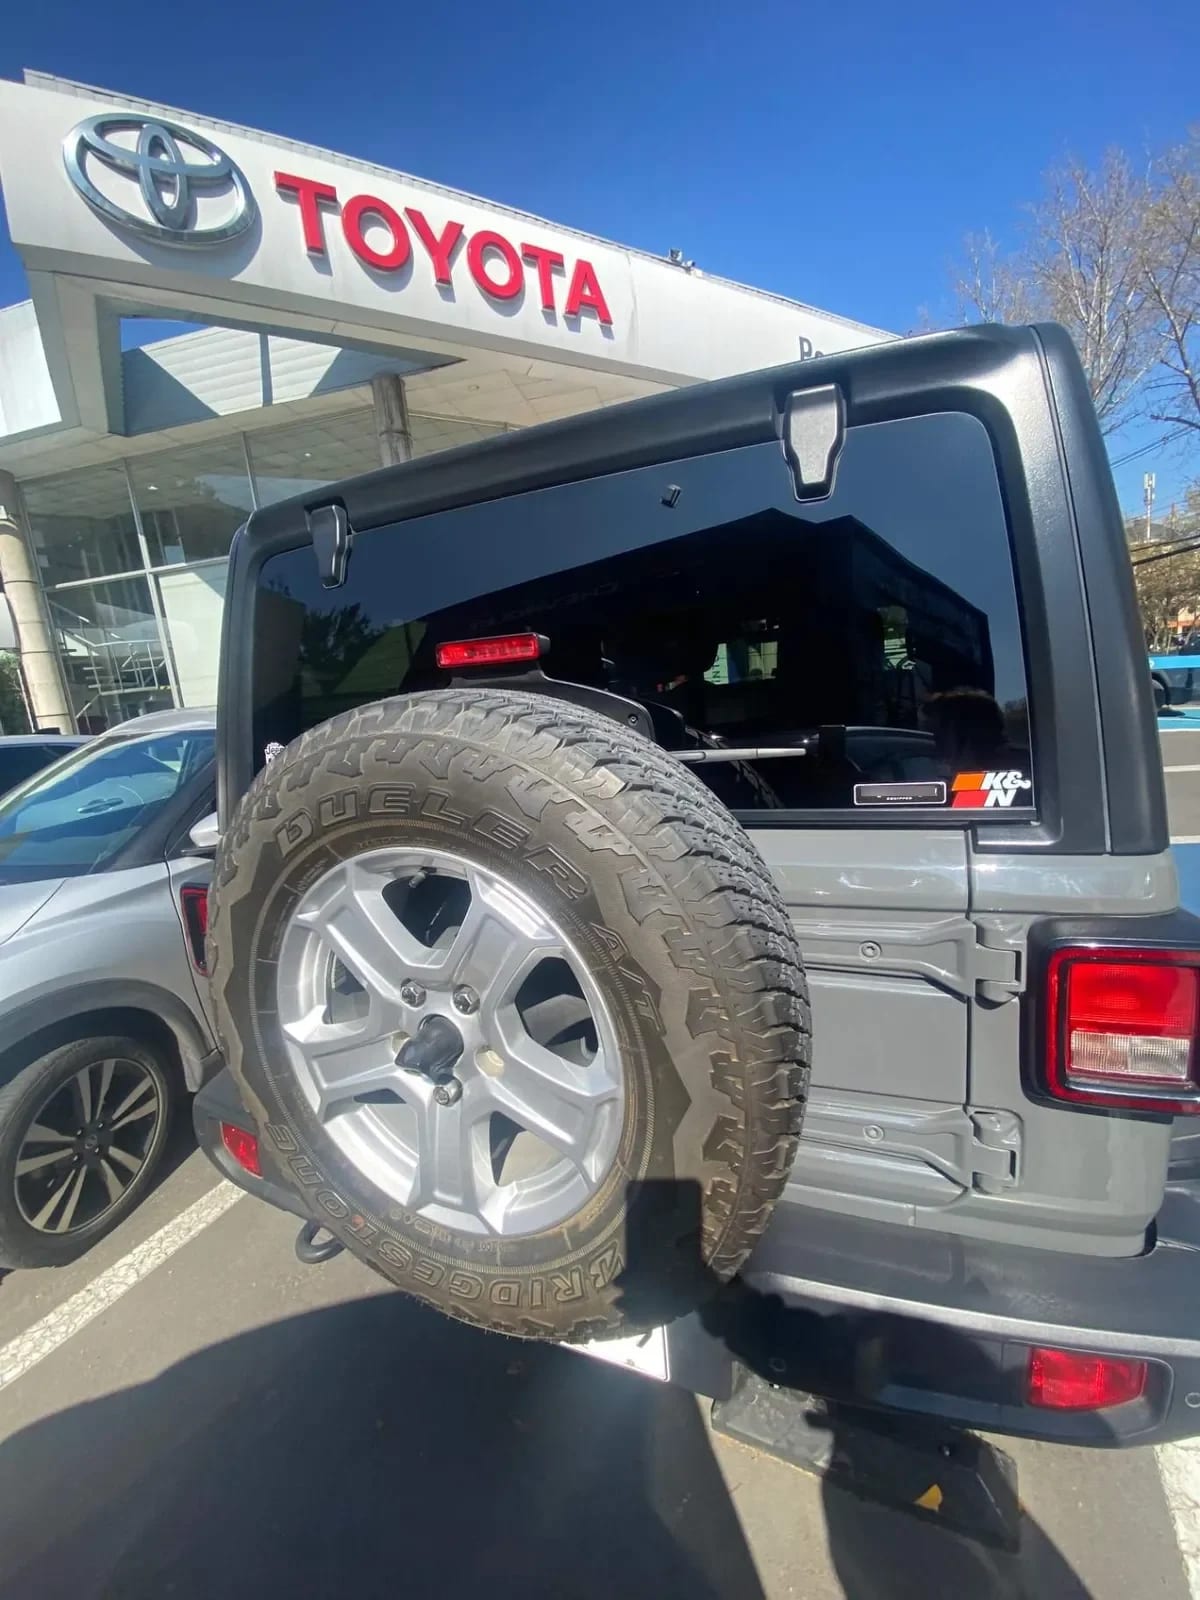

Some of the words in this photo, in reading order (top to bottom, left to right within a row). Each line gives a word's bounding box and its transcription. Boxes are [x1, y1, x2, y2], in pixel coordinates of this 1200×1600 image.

[274, 171, 613, 327] TOYOTA
[273, 782, 591, 900] DUELER
[264, 1122, 625, 1310] BRIDGESTONE
